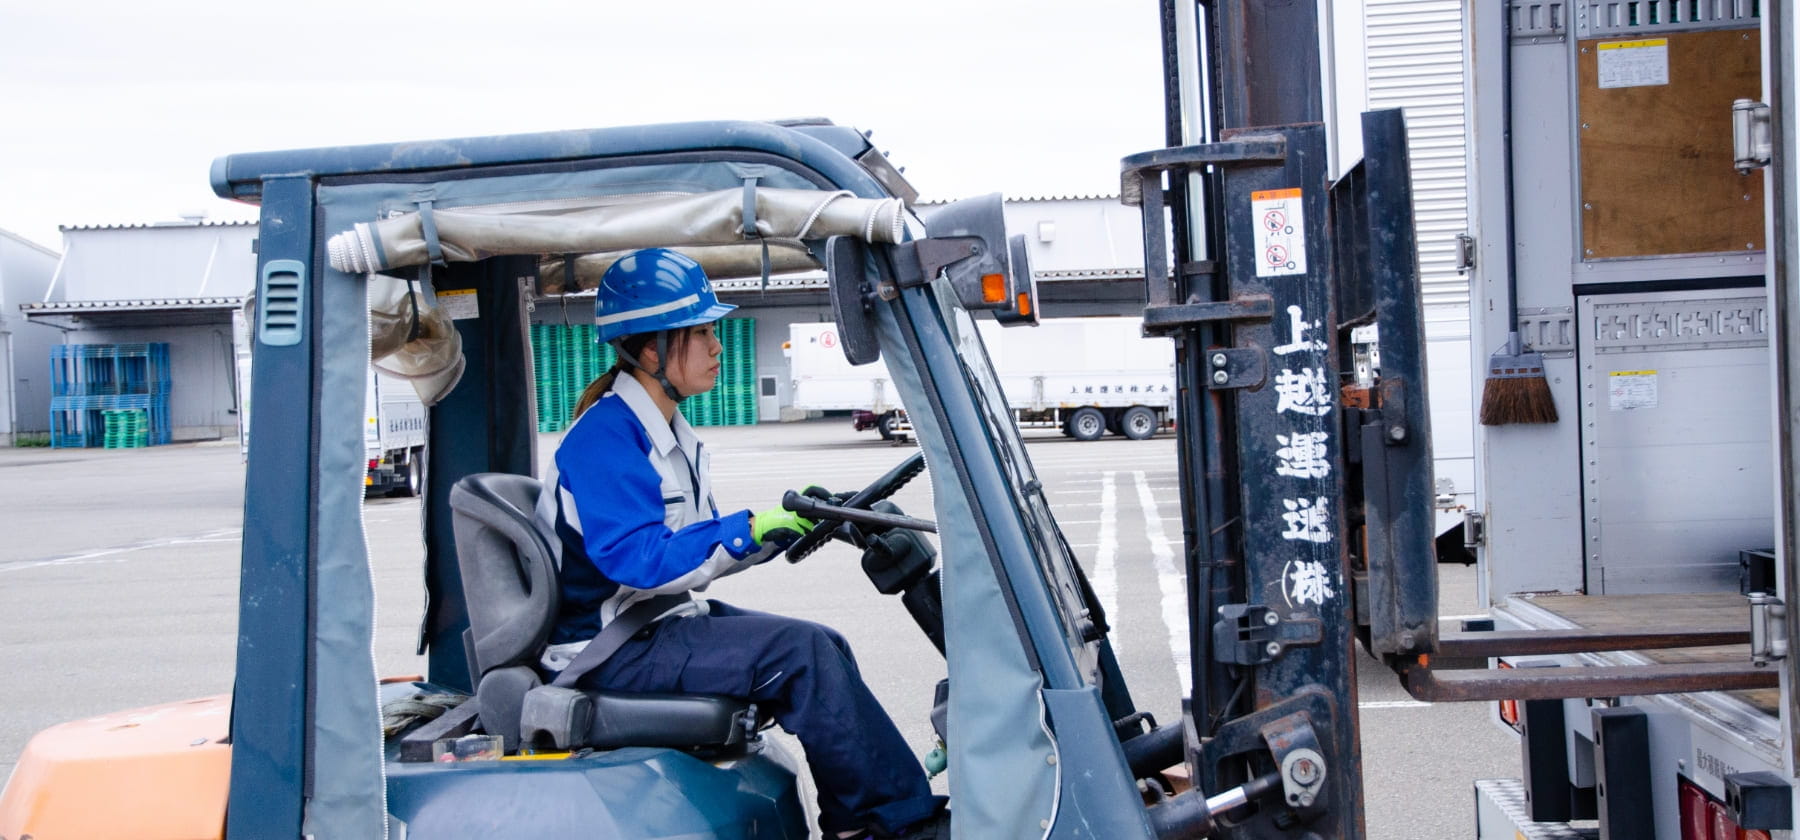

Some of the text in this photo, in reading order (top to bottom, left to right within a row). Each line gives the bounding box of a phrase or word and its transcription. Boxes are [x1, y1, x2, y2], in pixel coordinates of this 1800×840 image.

[1273, 305, 1343, 609] 上越運送(株
